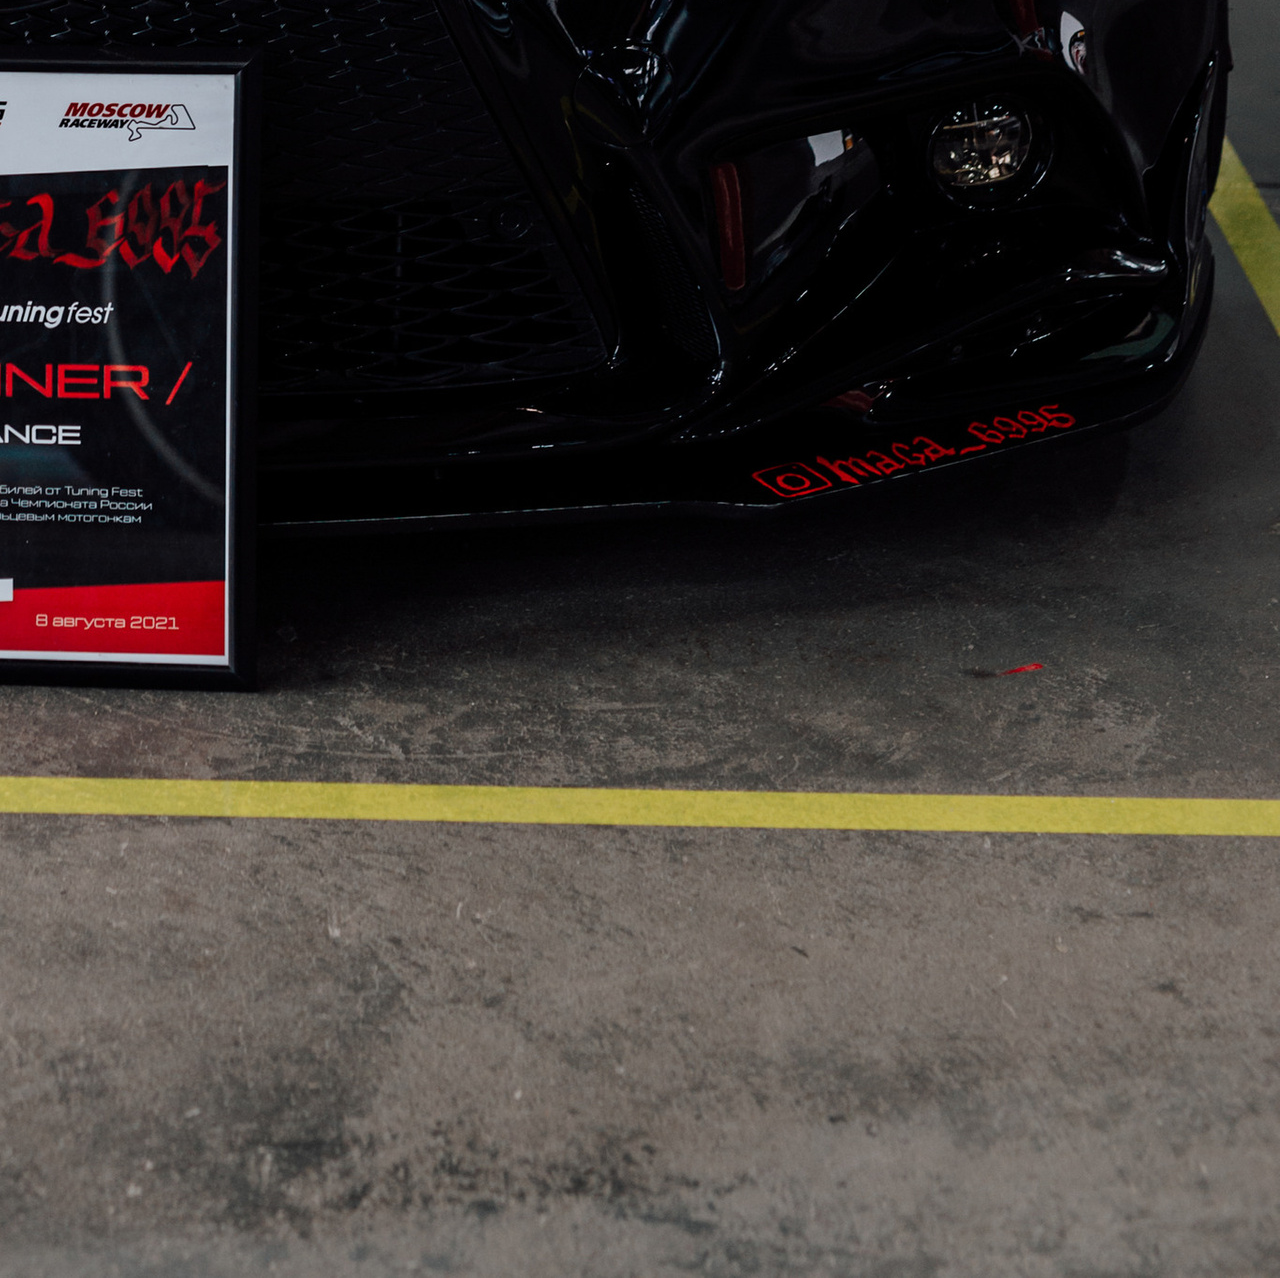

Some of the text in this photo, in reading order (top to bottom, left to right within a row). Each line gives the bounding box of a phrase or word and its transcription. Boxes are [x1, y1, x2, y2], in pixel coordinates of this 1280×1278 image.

[64, 101, 170, 119] MOSCOW
[58, 118, 131, 129] RACEWAY
[45, 487, 61, 495] от
[65, 486, 108, 498] Tuning
[111, 487, 143, 497] Fest
[11, 498, 97, 509] Чемпионата
[100, 499, 153, 510] России
[58, 514, 142, 523] мотогонкам
[52, 616, 126, 630] августа
[130, 616, 180, 630] 2021
